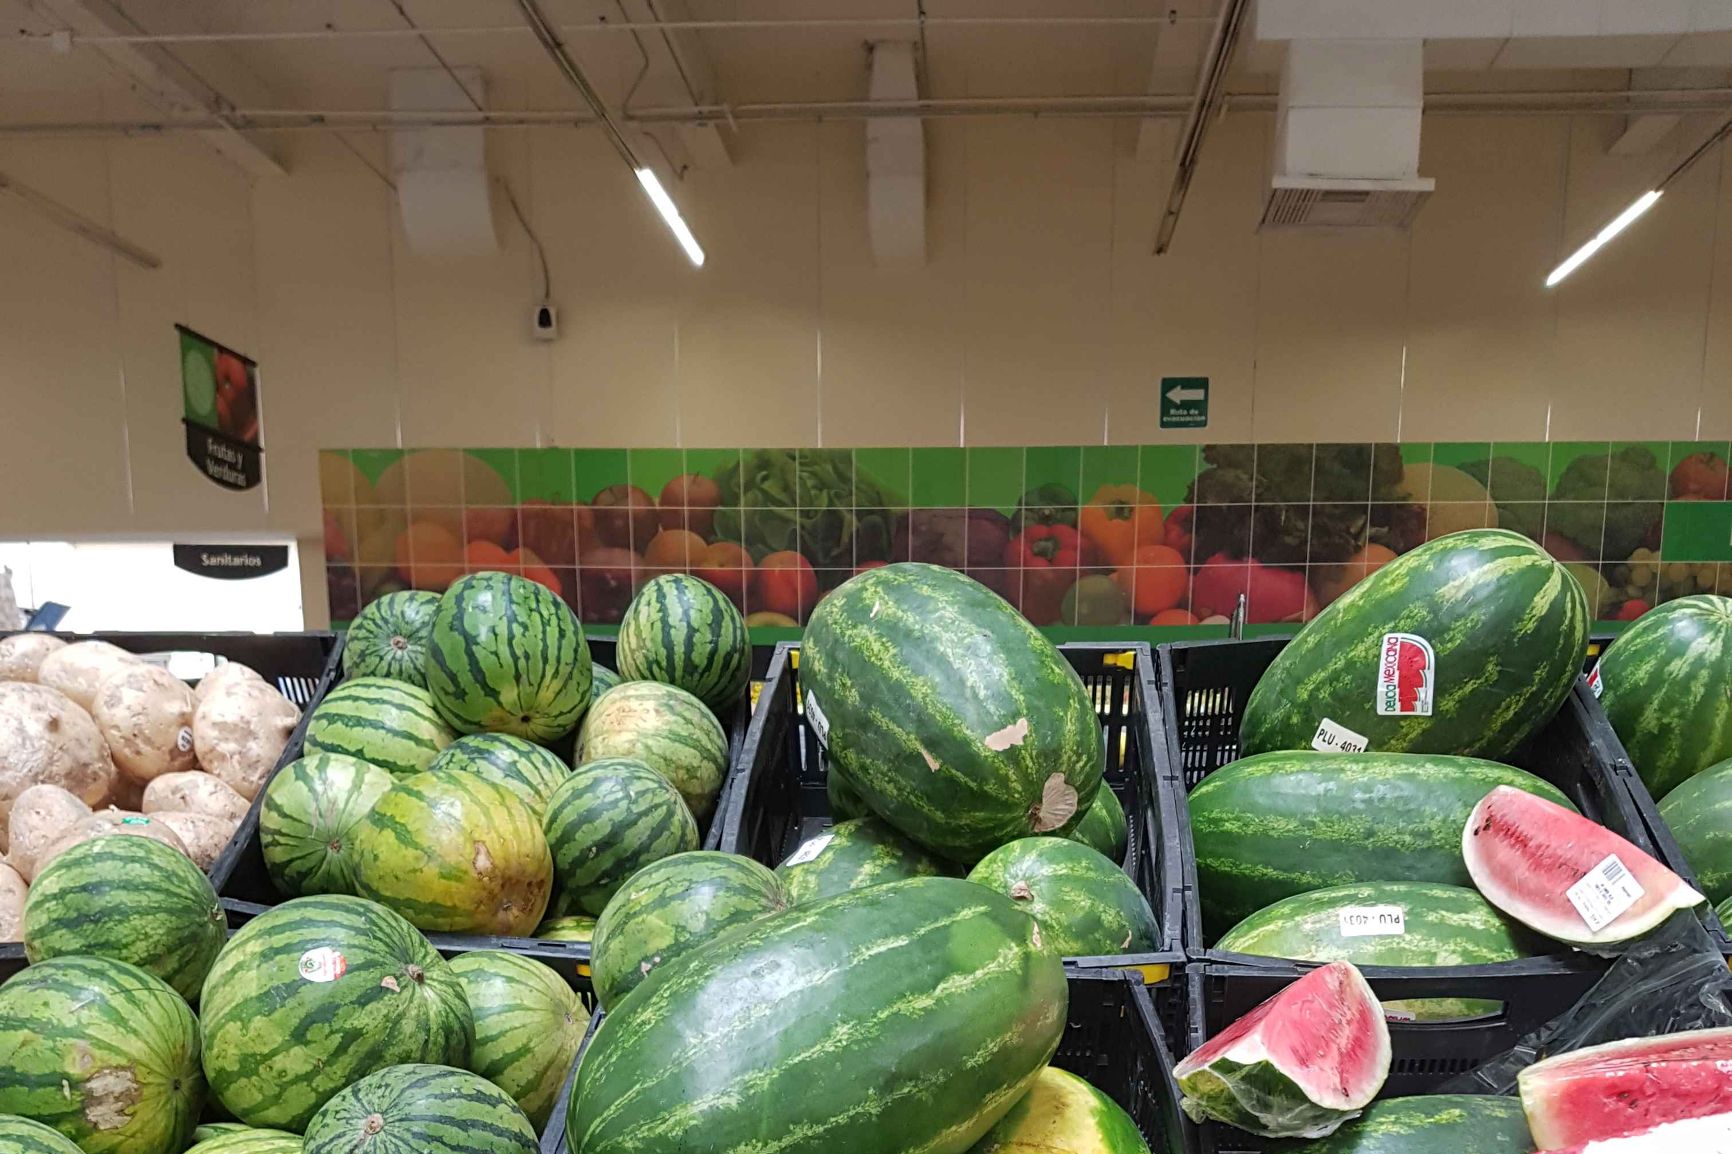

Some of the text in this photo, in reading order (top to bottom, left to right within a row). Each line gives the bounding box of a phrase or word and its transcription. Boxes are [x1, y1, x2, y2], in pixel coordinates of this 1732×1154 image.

[201, 553, 262, 567] Sanitarios
[1316, 728, 1336, 746] PLU
[1379, 914, 1400, 924] PLU
